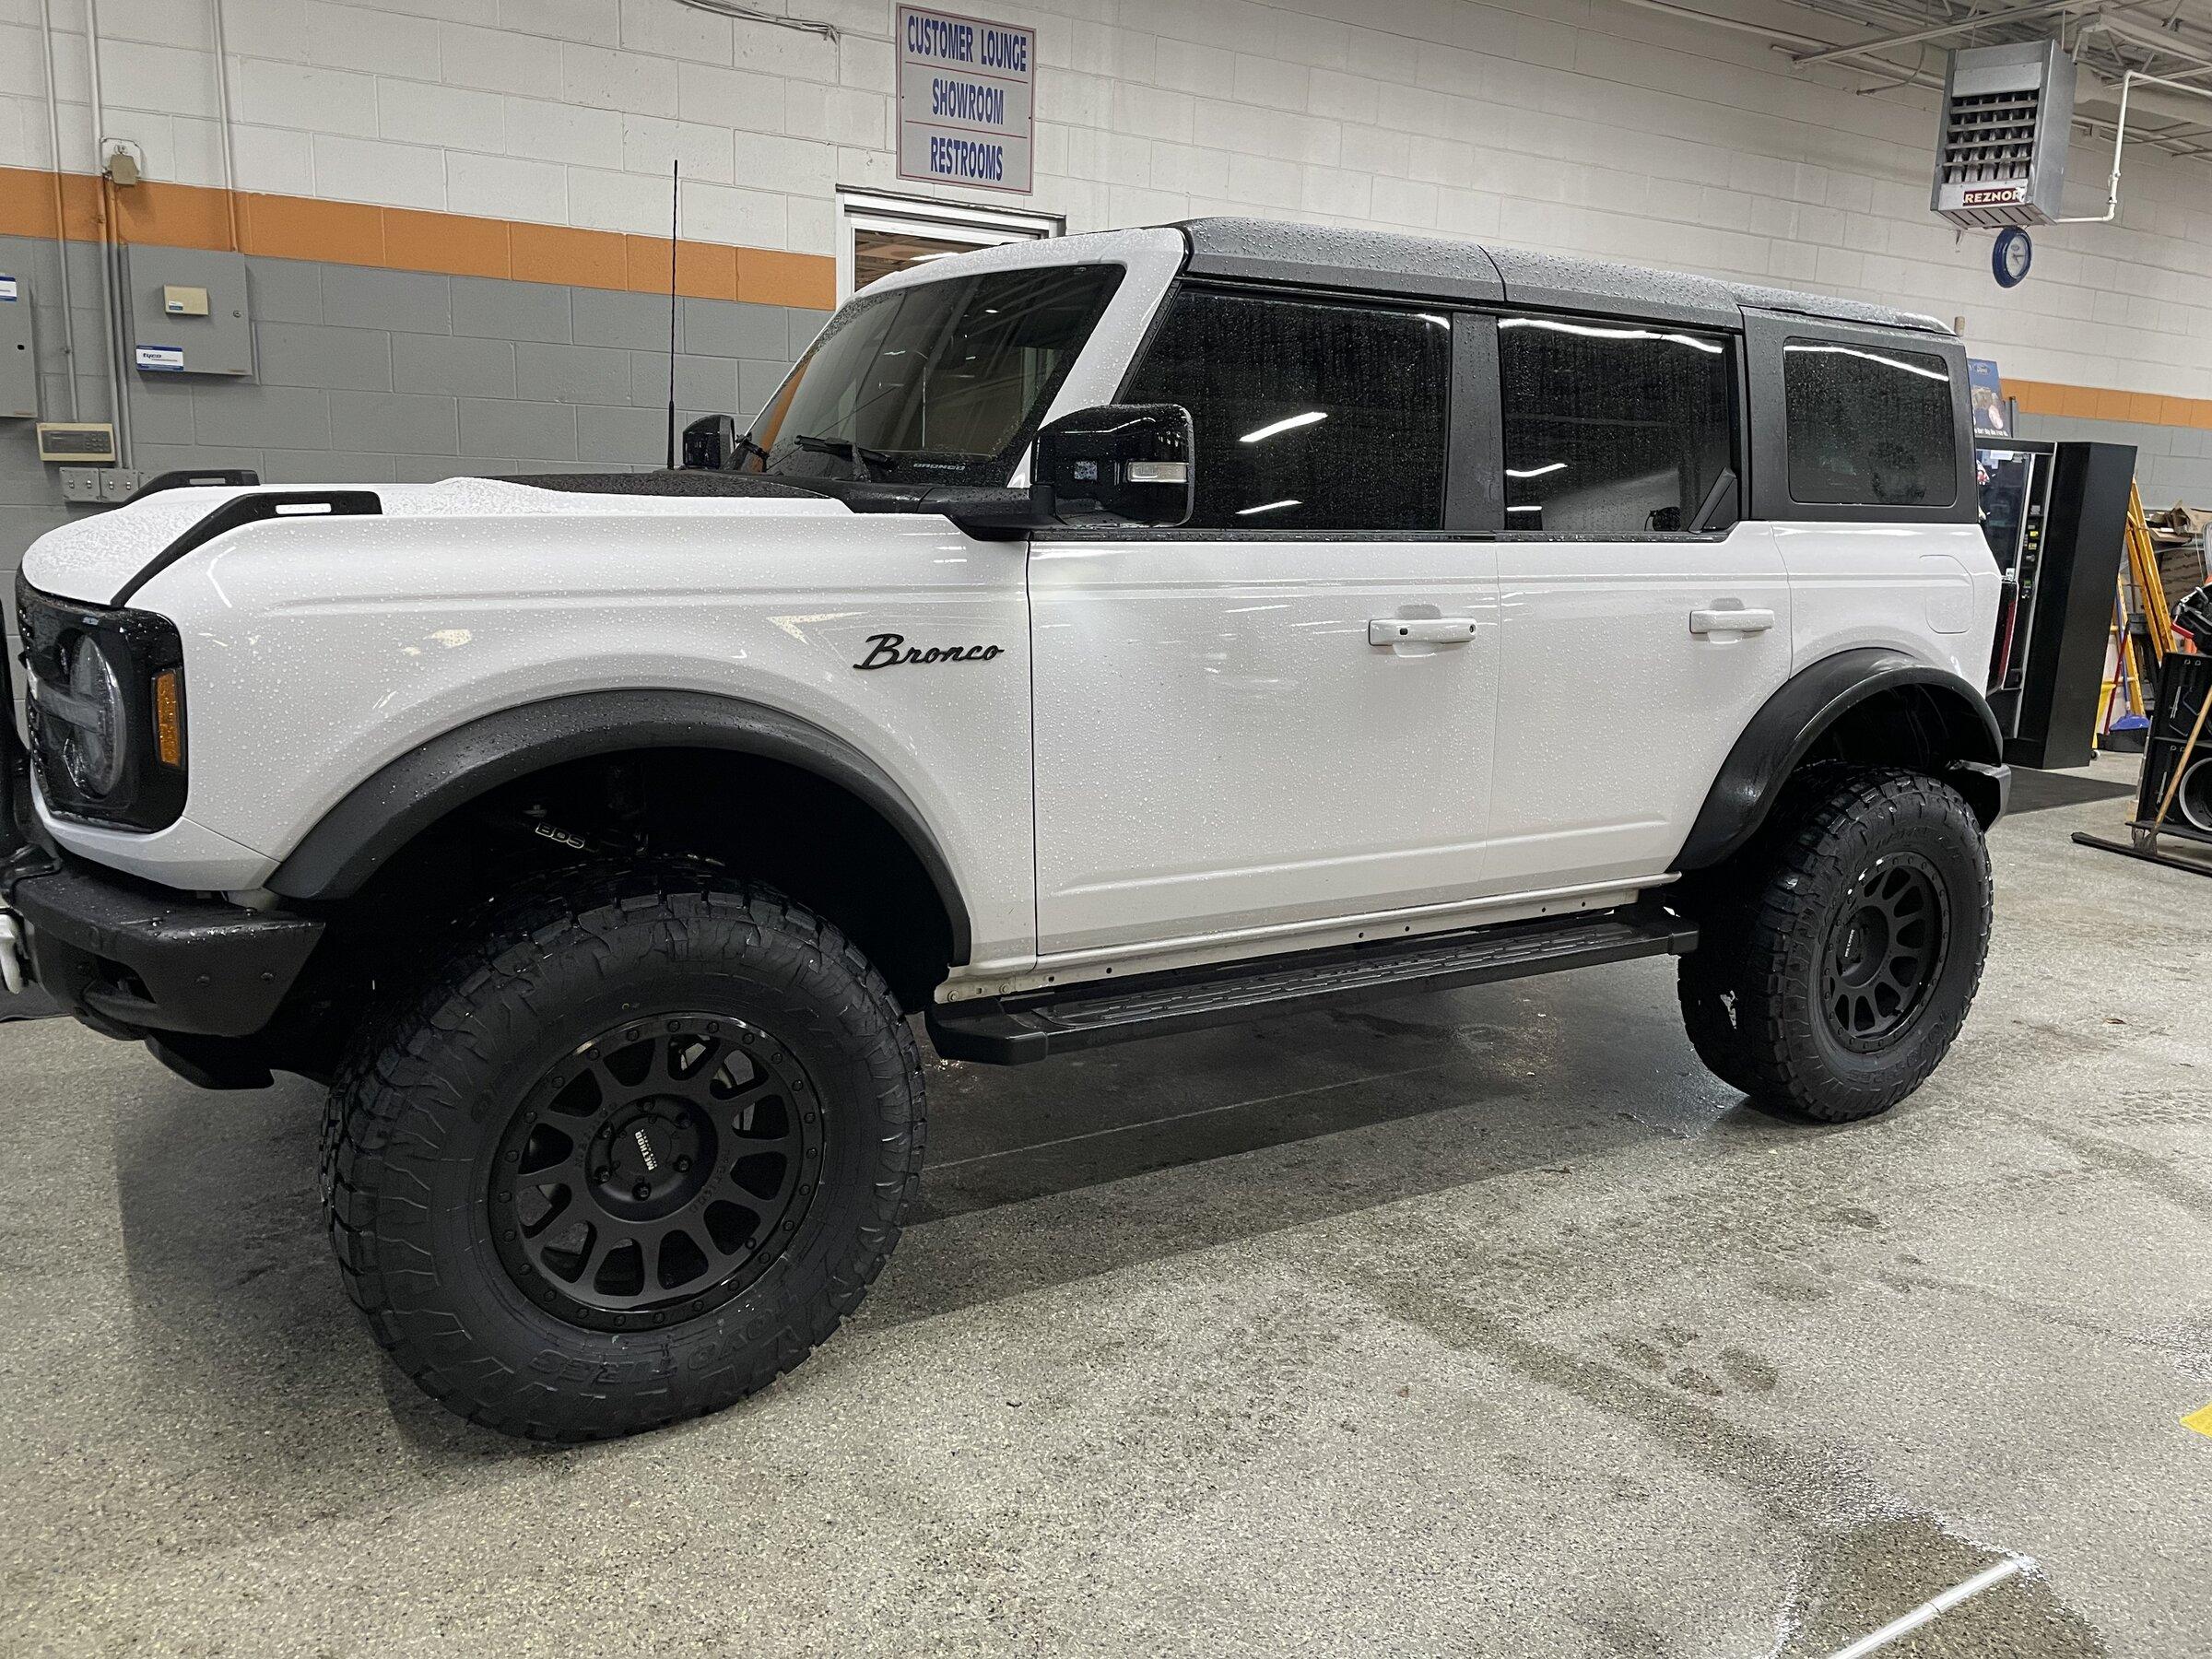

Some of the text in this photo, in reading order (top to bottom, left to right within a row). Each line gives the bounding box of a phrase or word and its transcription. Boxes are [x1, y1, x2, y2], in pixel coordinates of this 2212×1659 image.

[908, 15, 1027, 72] CUSTOMER LOUNGE
[932, 77, 1004, 125] SHOWROOM
[931, 136, 1003, 182] RESTROOMS
[853, 633, 1005, 670] Bronco
[635, 1131, 654, 1171] METHOD
